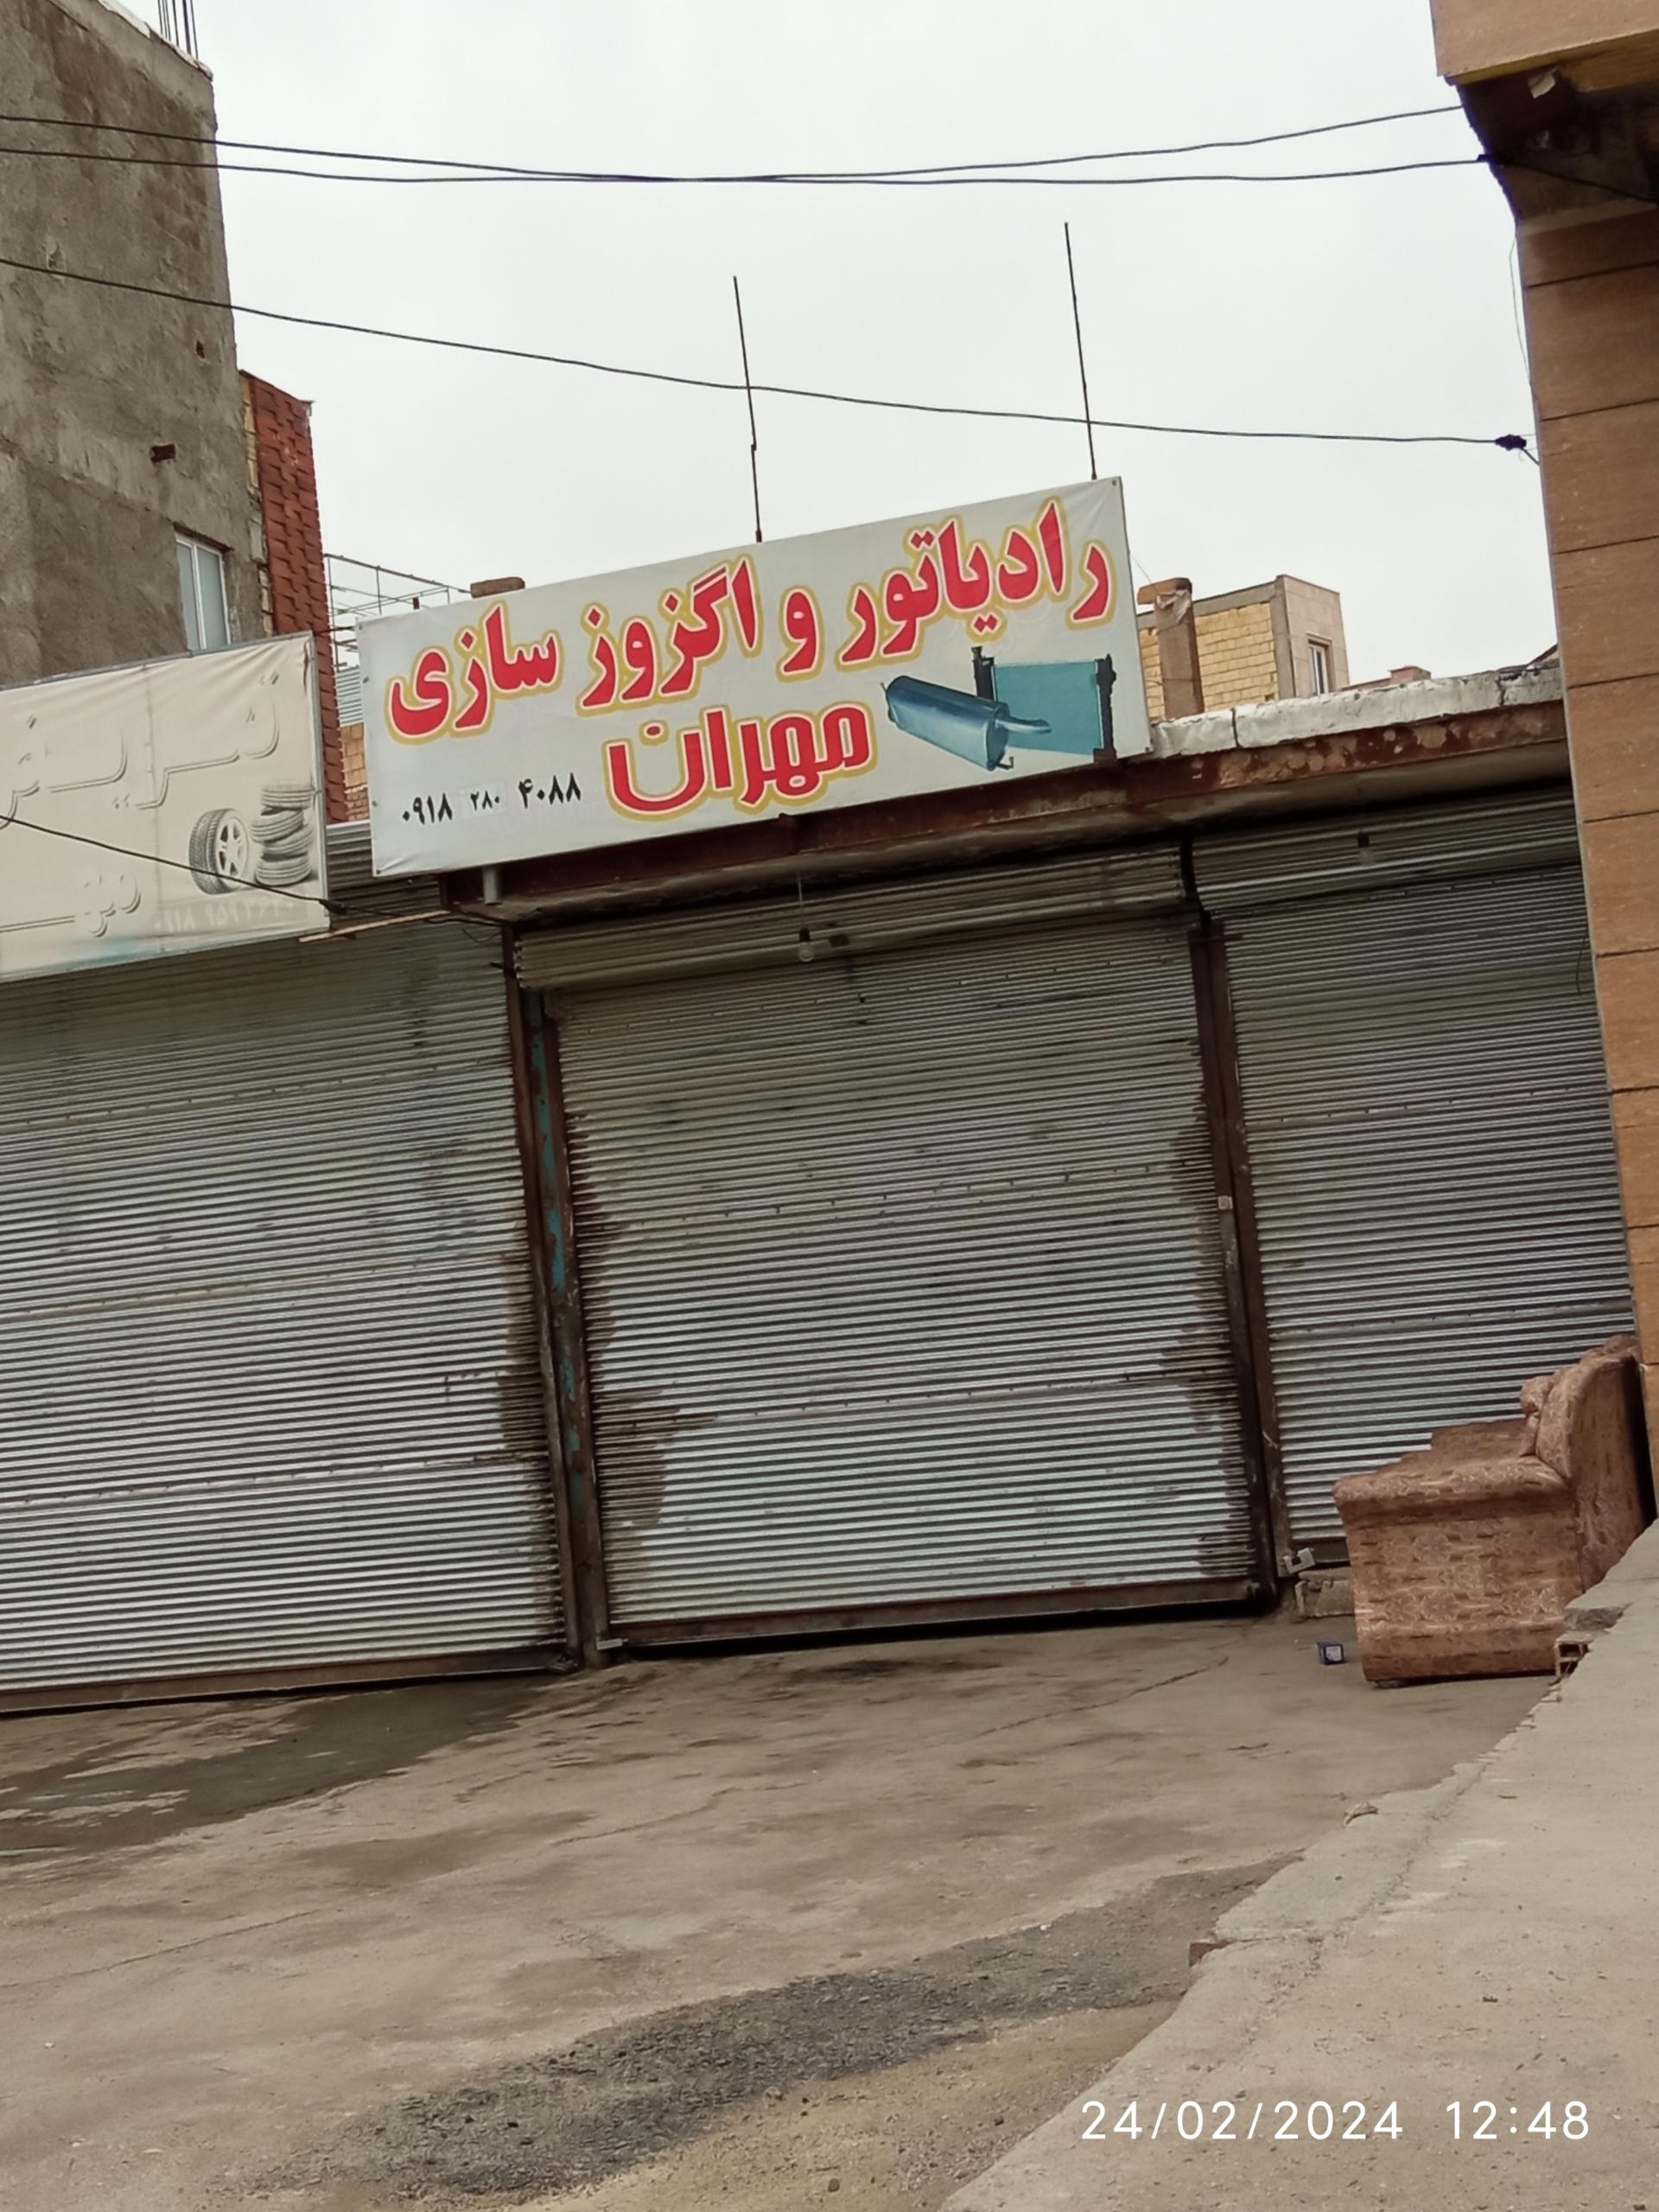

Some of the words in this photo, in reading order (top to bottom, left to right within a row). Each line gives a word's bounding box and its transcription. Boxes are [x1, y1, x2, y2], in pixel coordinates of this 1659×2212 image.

[580, 557, 760, 712] اگزوز
[781, 588, 822, 677] و
[840, 501, 1114, 665] رادیاتور
[388, 602, 560, 741] سازی
[402, 792, 453, 825] ۰۹۱۸
[469, 790, 500, 811] ۲۸۰
[518, 772, 582, 810] ۴۰۸۸
[605, 702, 874, 816] مهران
